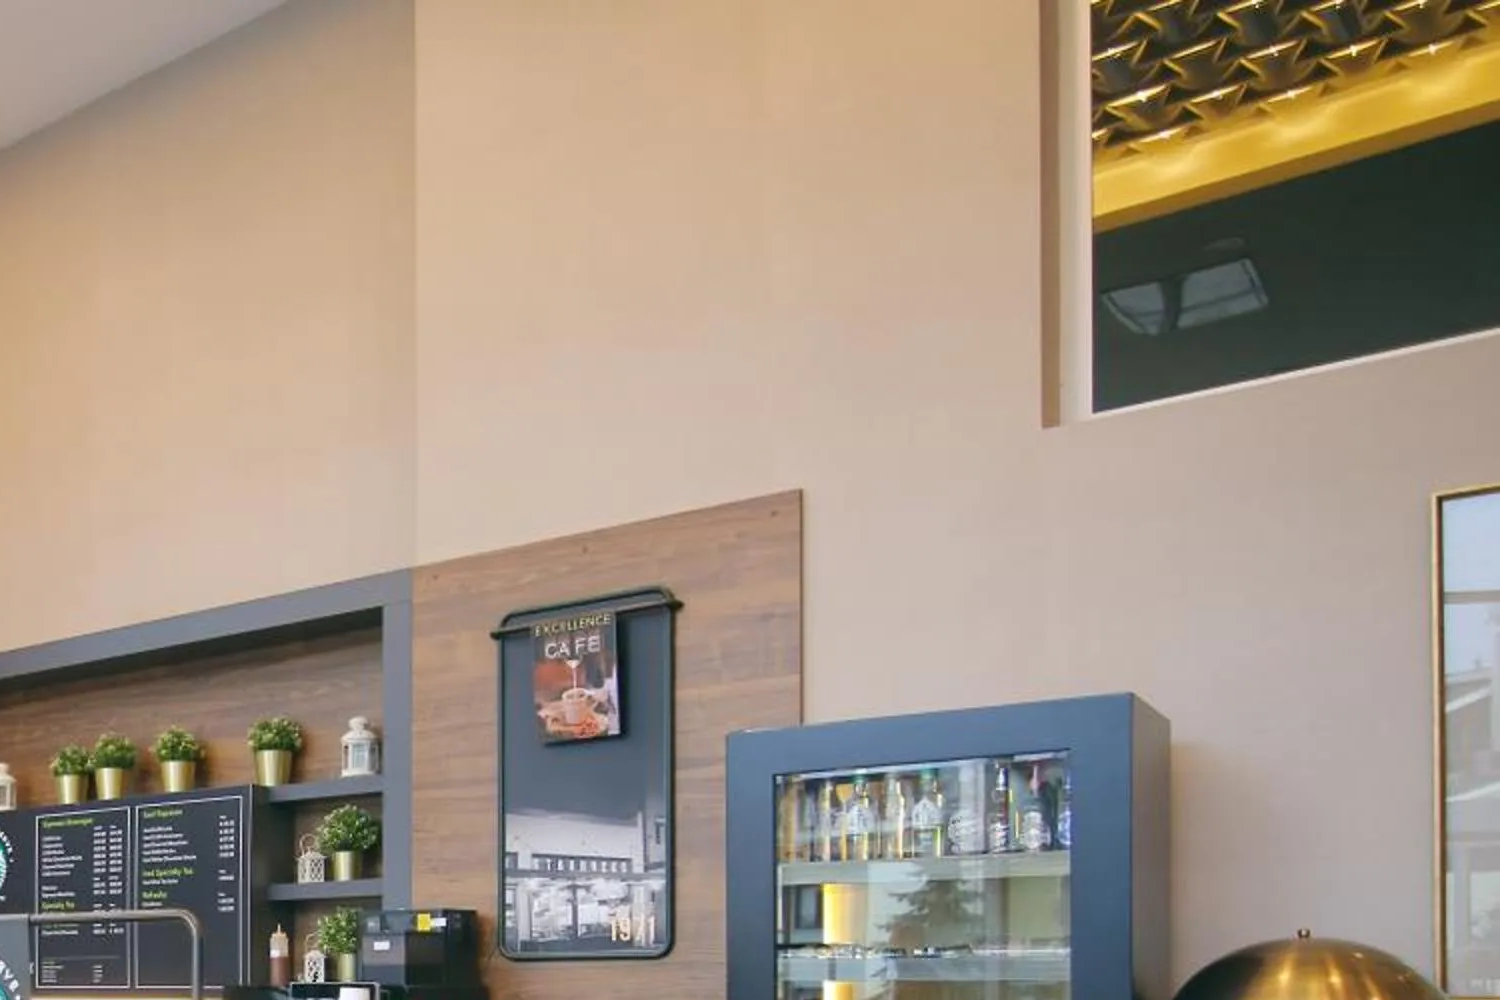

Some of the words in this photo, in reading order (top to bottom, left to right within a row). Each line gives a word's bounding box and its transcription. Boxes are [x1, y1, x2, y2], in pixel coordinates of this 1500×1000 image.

[534, 612, 612, 638] EXCELLENCE
[544, 634, 601, 659] CAFE
[610, 914, 657, 946] 1971
